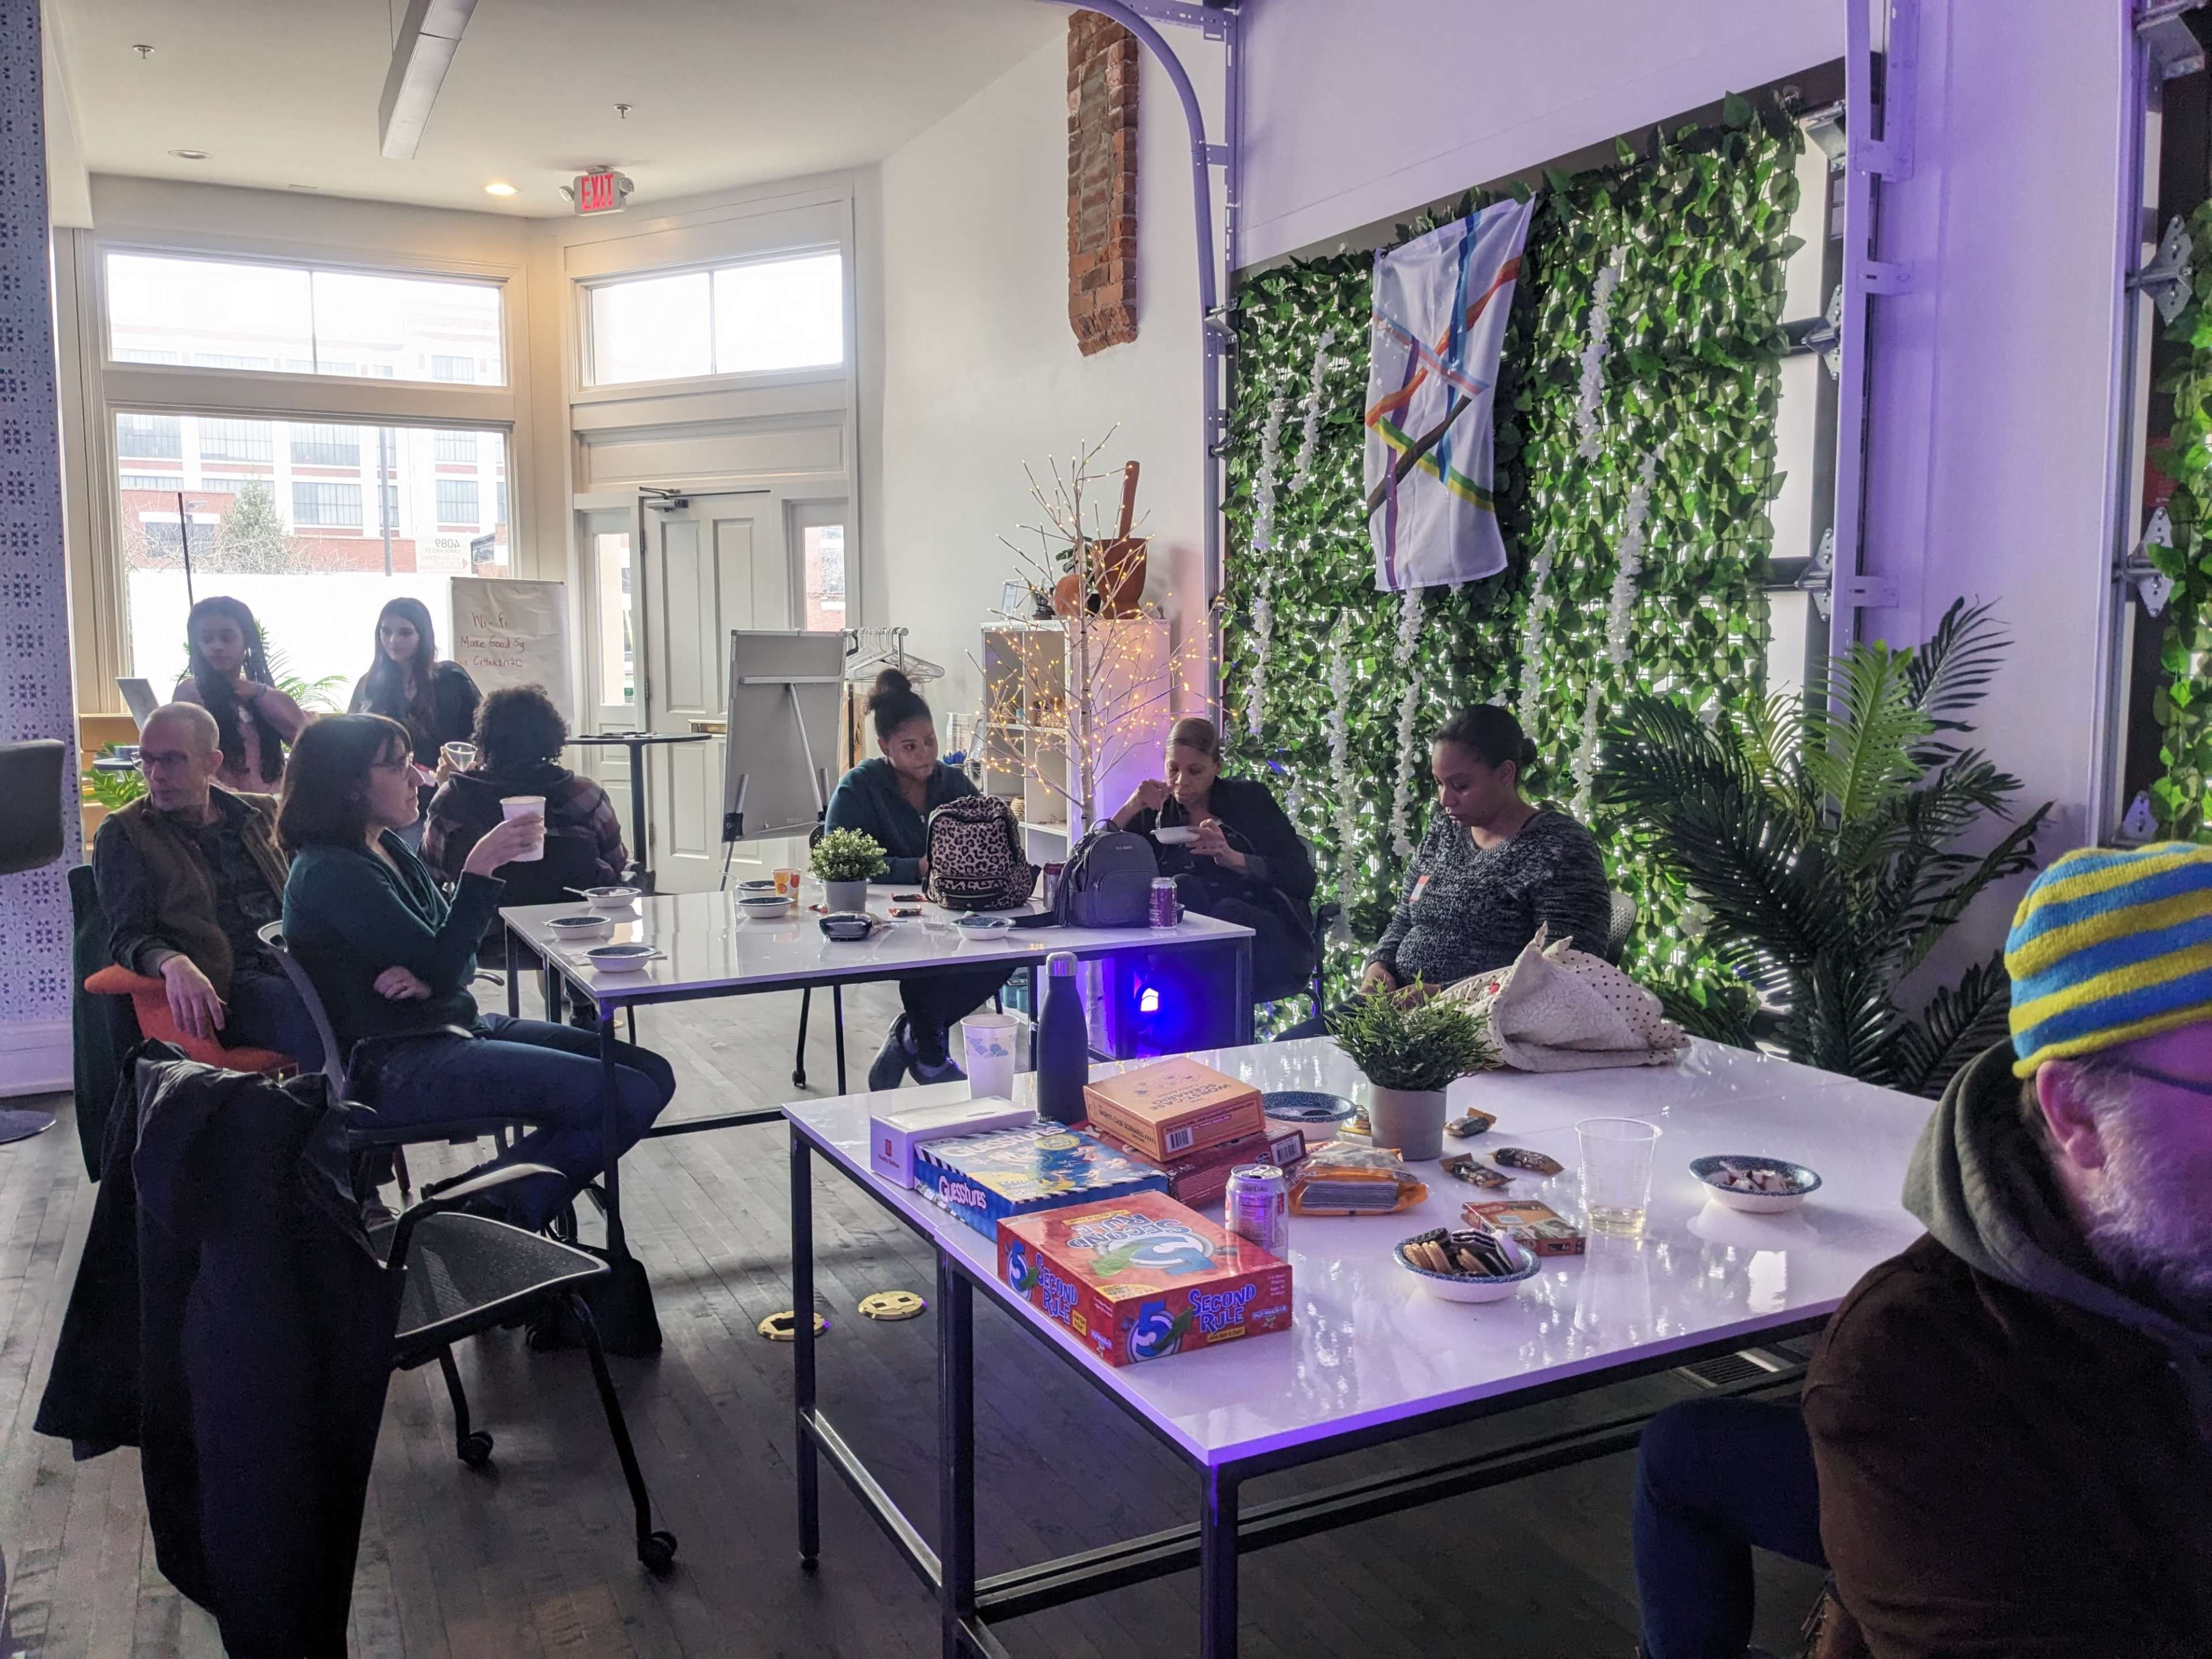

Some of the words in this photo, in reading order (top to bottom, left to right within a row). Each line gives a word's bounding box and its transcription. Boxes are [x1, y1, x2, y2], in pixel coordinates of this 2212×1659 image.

[581, 173, 613, 211] EXIT
[460, 635, 485, 649] Make
[490, 635, 510, 649] Good
[1067, 1218, 1192, 1249] SECOND
[1071, 1213, 1154, 1235] RULE
[1036, 1252, 1078, 1306] SECOND
[1043, 1286, 1071, 1325] RULE
[1188, 1284, 1257, 1317] SECOND
[1200, 1306, 1244, 1334] RULE
